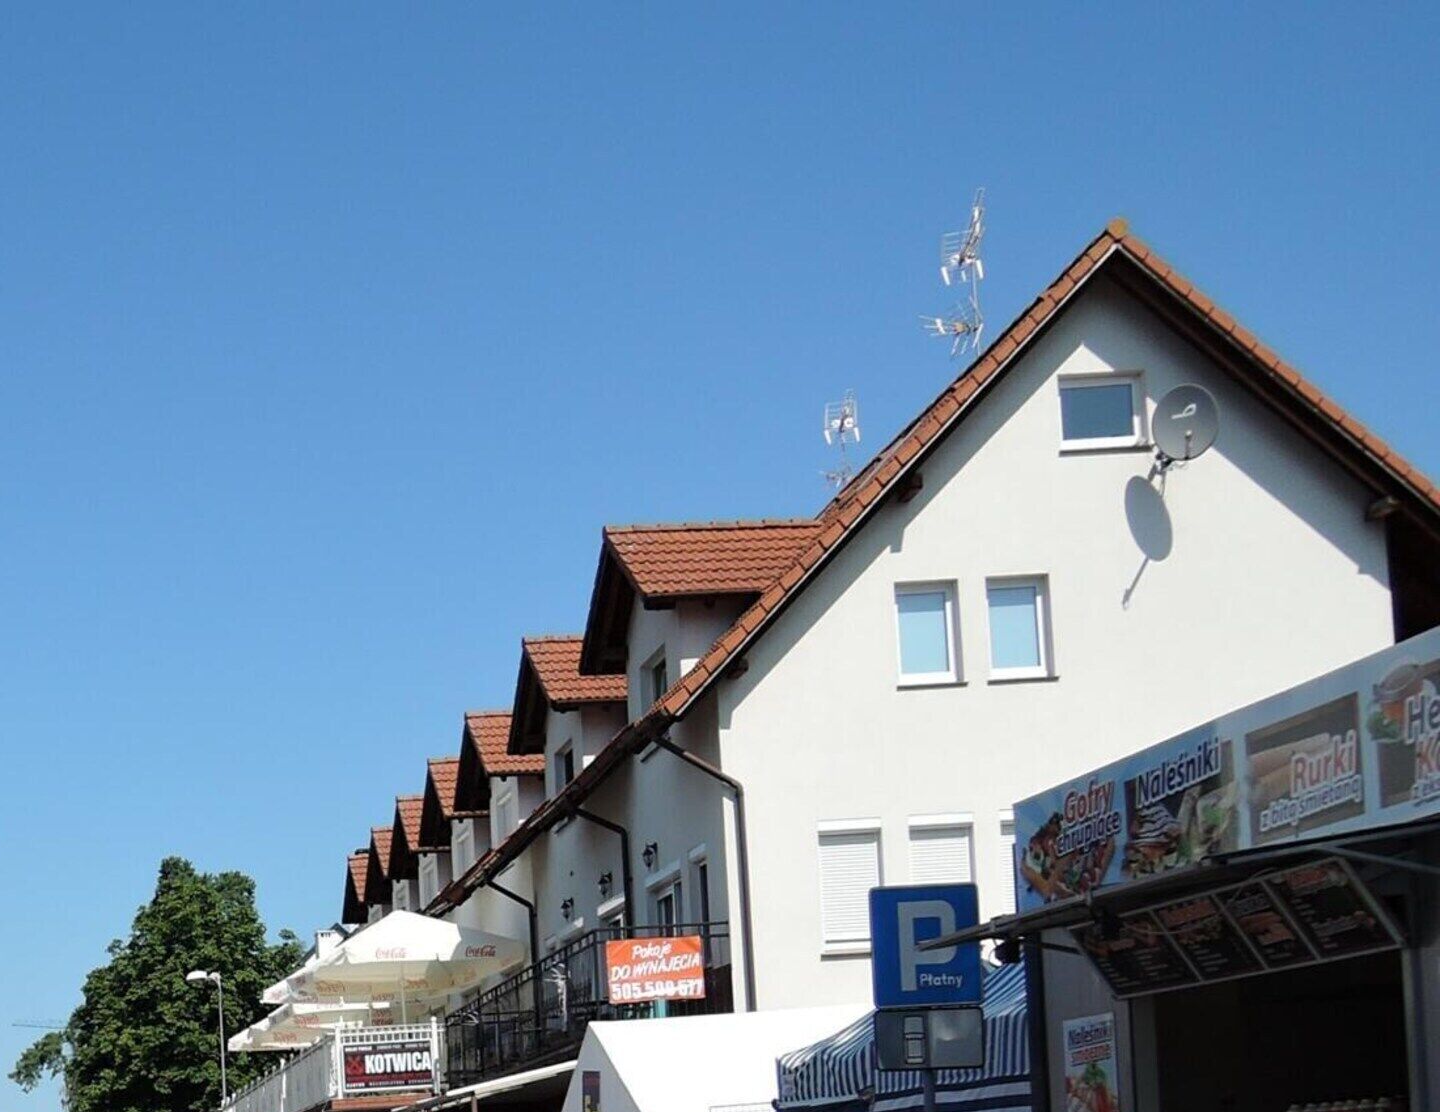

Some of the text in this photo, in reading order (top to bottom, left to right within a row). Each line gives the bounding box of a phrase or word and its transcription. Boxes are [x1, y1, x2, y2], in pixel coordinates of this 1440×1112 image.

[1136, 742, 1221, 805] Naleśniki
[1292, 731, 1357, 796] Rurki
[1063, 780, 1114, 823] Gofry
[632, 941, 672, 960] Pokoje
[897, 899, 957, 992] P
[611, 964, 631, 982] DO
[920, 973, 963, 988] Płatny
[365, 1051, 432, 1074] KOTWICA
